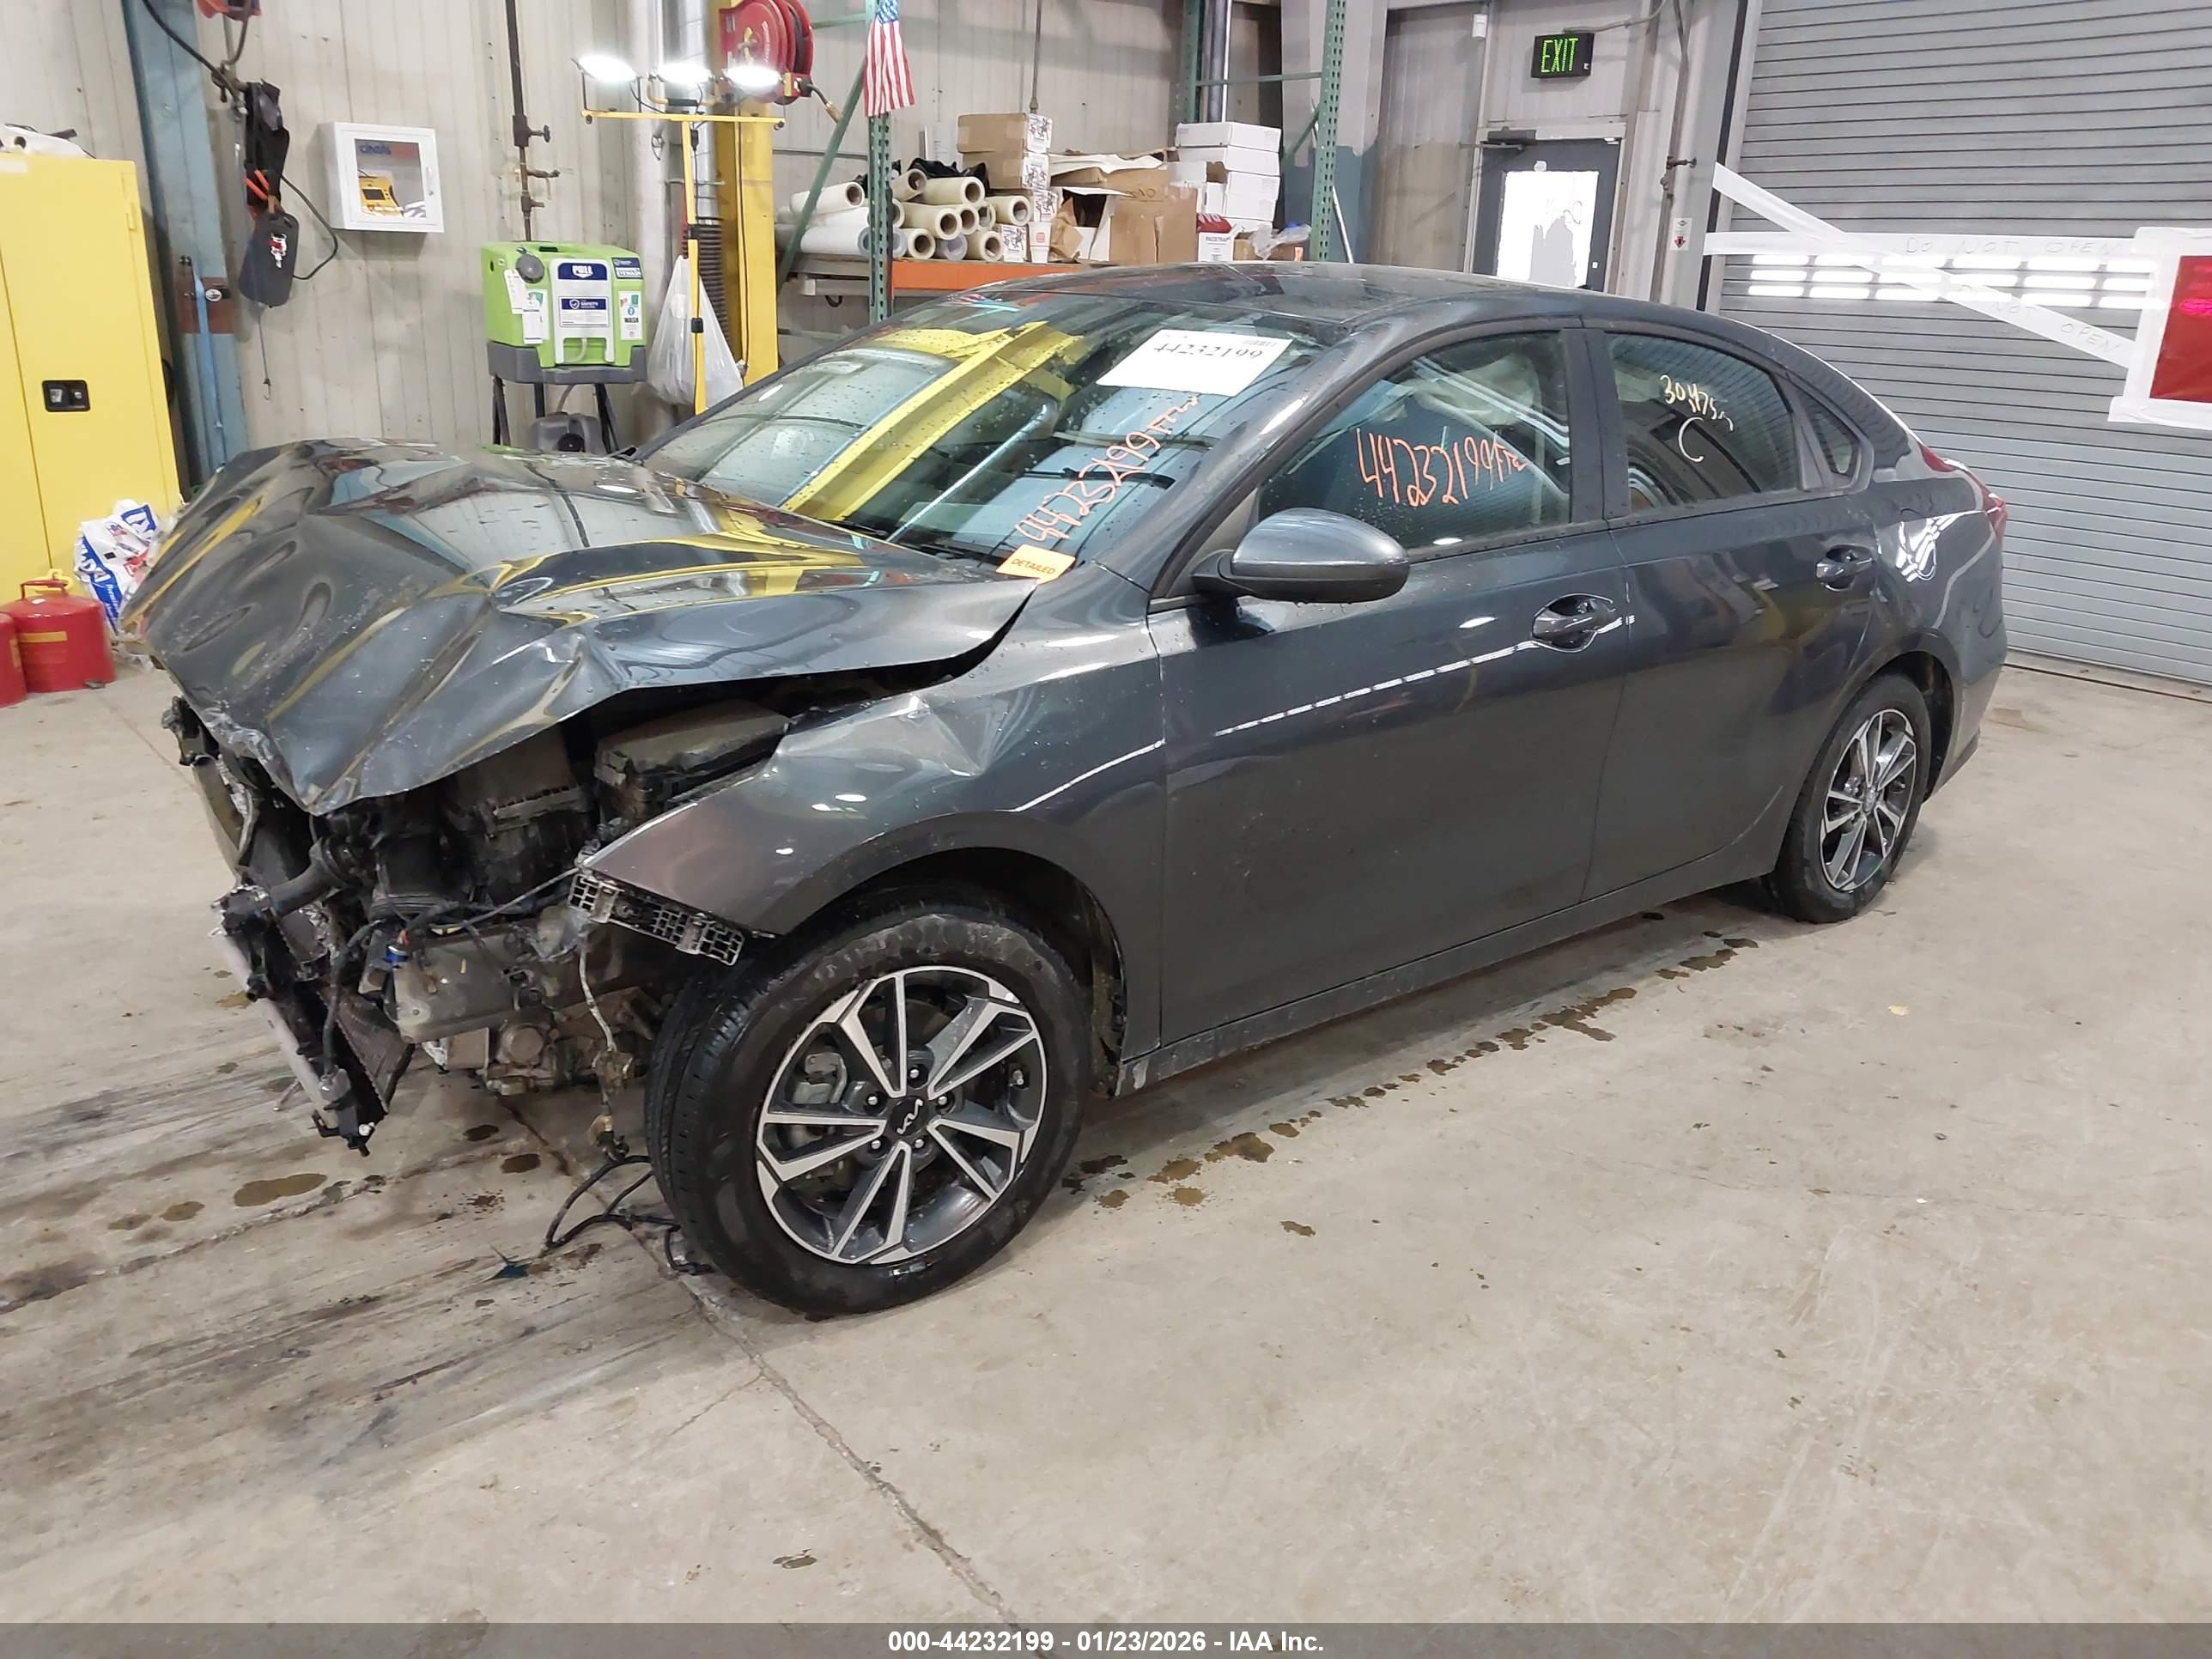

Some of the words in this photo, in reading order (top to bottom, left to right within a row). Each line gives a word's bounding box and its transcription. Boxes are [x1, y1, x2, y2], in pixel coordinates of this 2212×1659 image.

[1540, 38, 1578, 72] EXIT
[1154, 343, 1263, 358] 44232199
[1010, 557, 1055, 574] DETAILED
